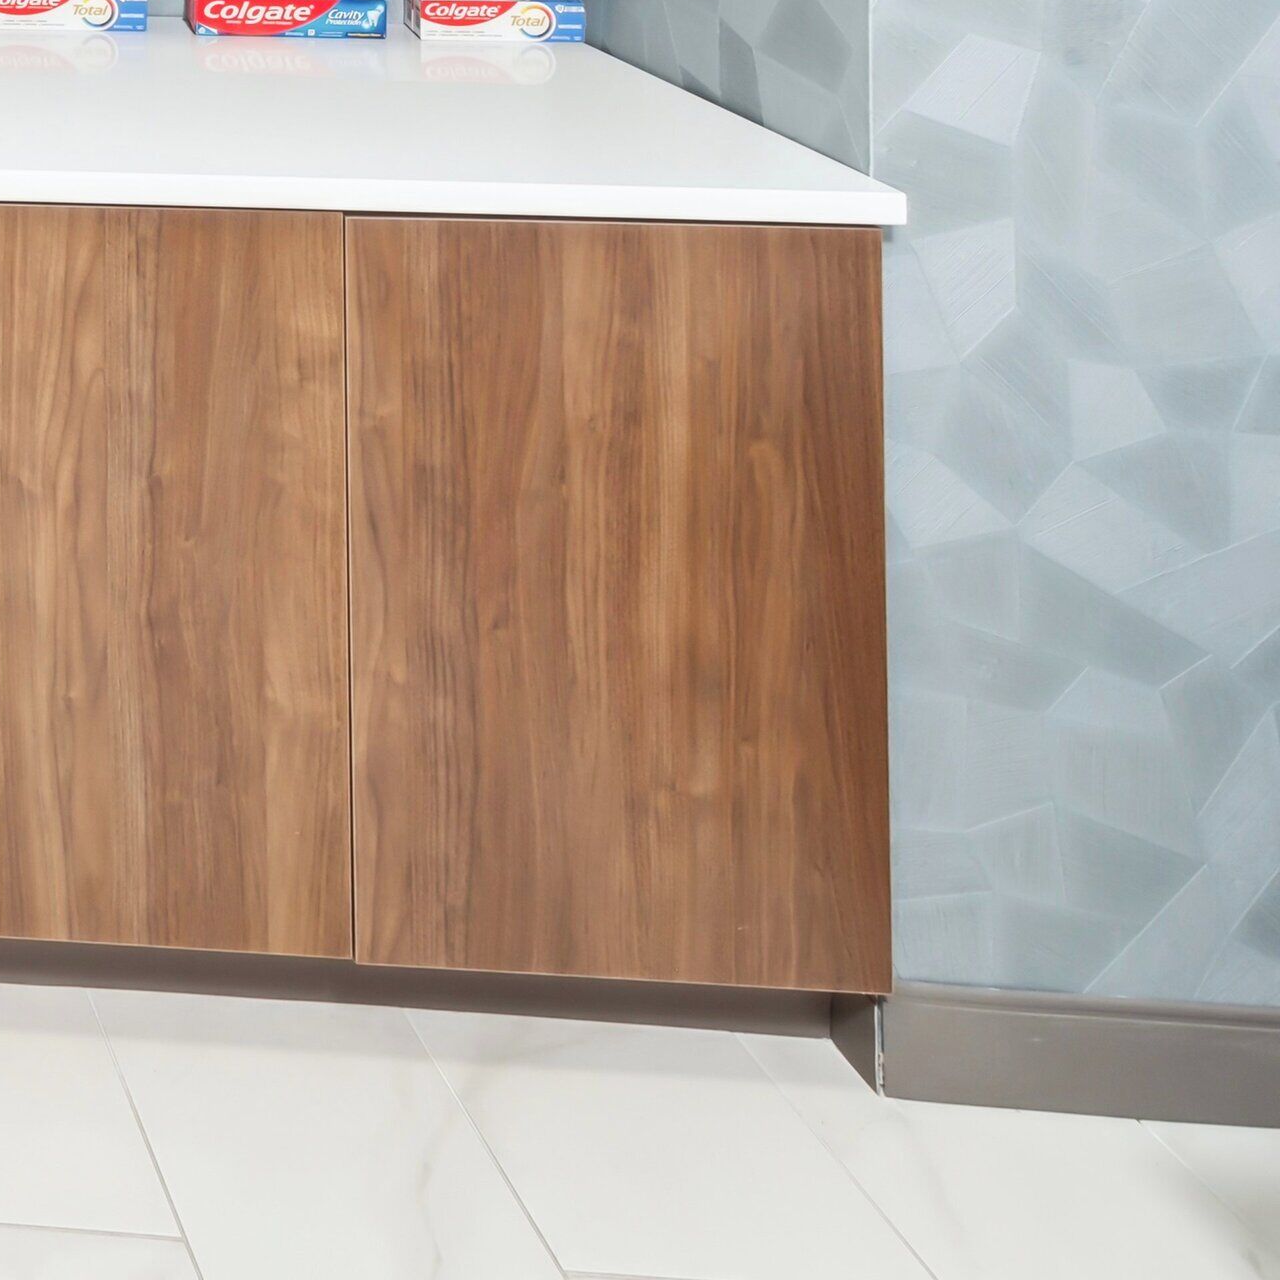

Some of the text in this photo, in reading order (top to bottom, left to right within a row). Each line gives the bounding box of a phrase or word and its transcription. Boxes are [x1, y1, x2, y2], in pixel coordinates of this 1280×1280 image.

[72, 4, 108, 16] Total
[203, 0, 311, 24] Colgate
[328, 9, 364, 20] Cavity
[424, 3, 499, 20] Colgate
[325, 18, 362, 26] Protection
[510, 15, 545, 27] Total
